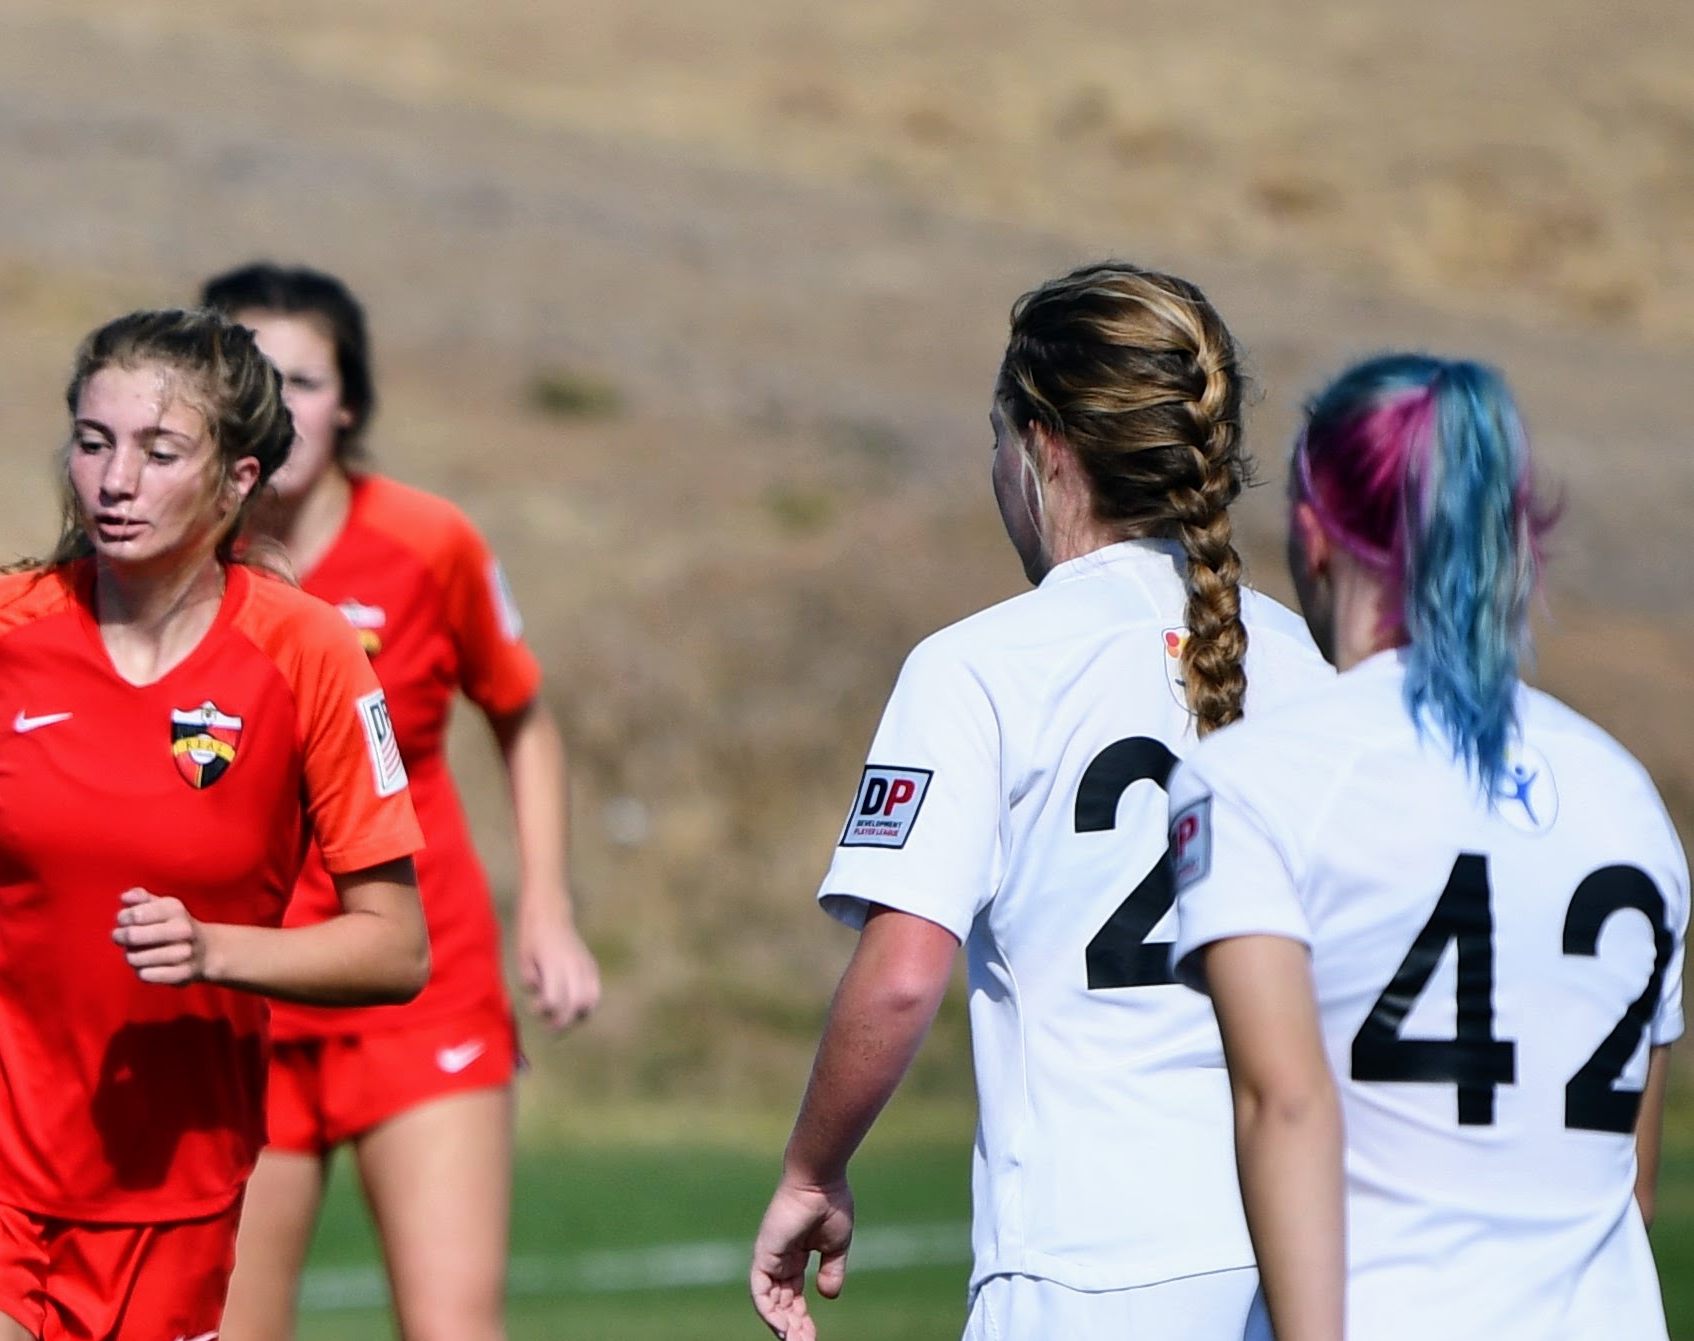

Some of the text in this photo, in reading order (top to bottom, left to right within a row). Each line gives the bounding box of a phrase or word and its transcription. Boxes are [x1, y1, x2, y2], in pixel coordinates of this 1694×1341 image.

[185, 739, 223, 752] REAL
[860, 777, 915, 817] DP
[1350, 853, 1674, 1134] 42
